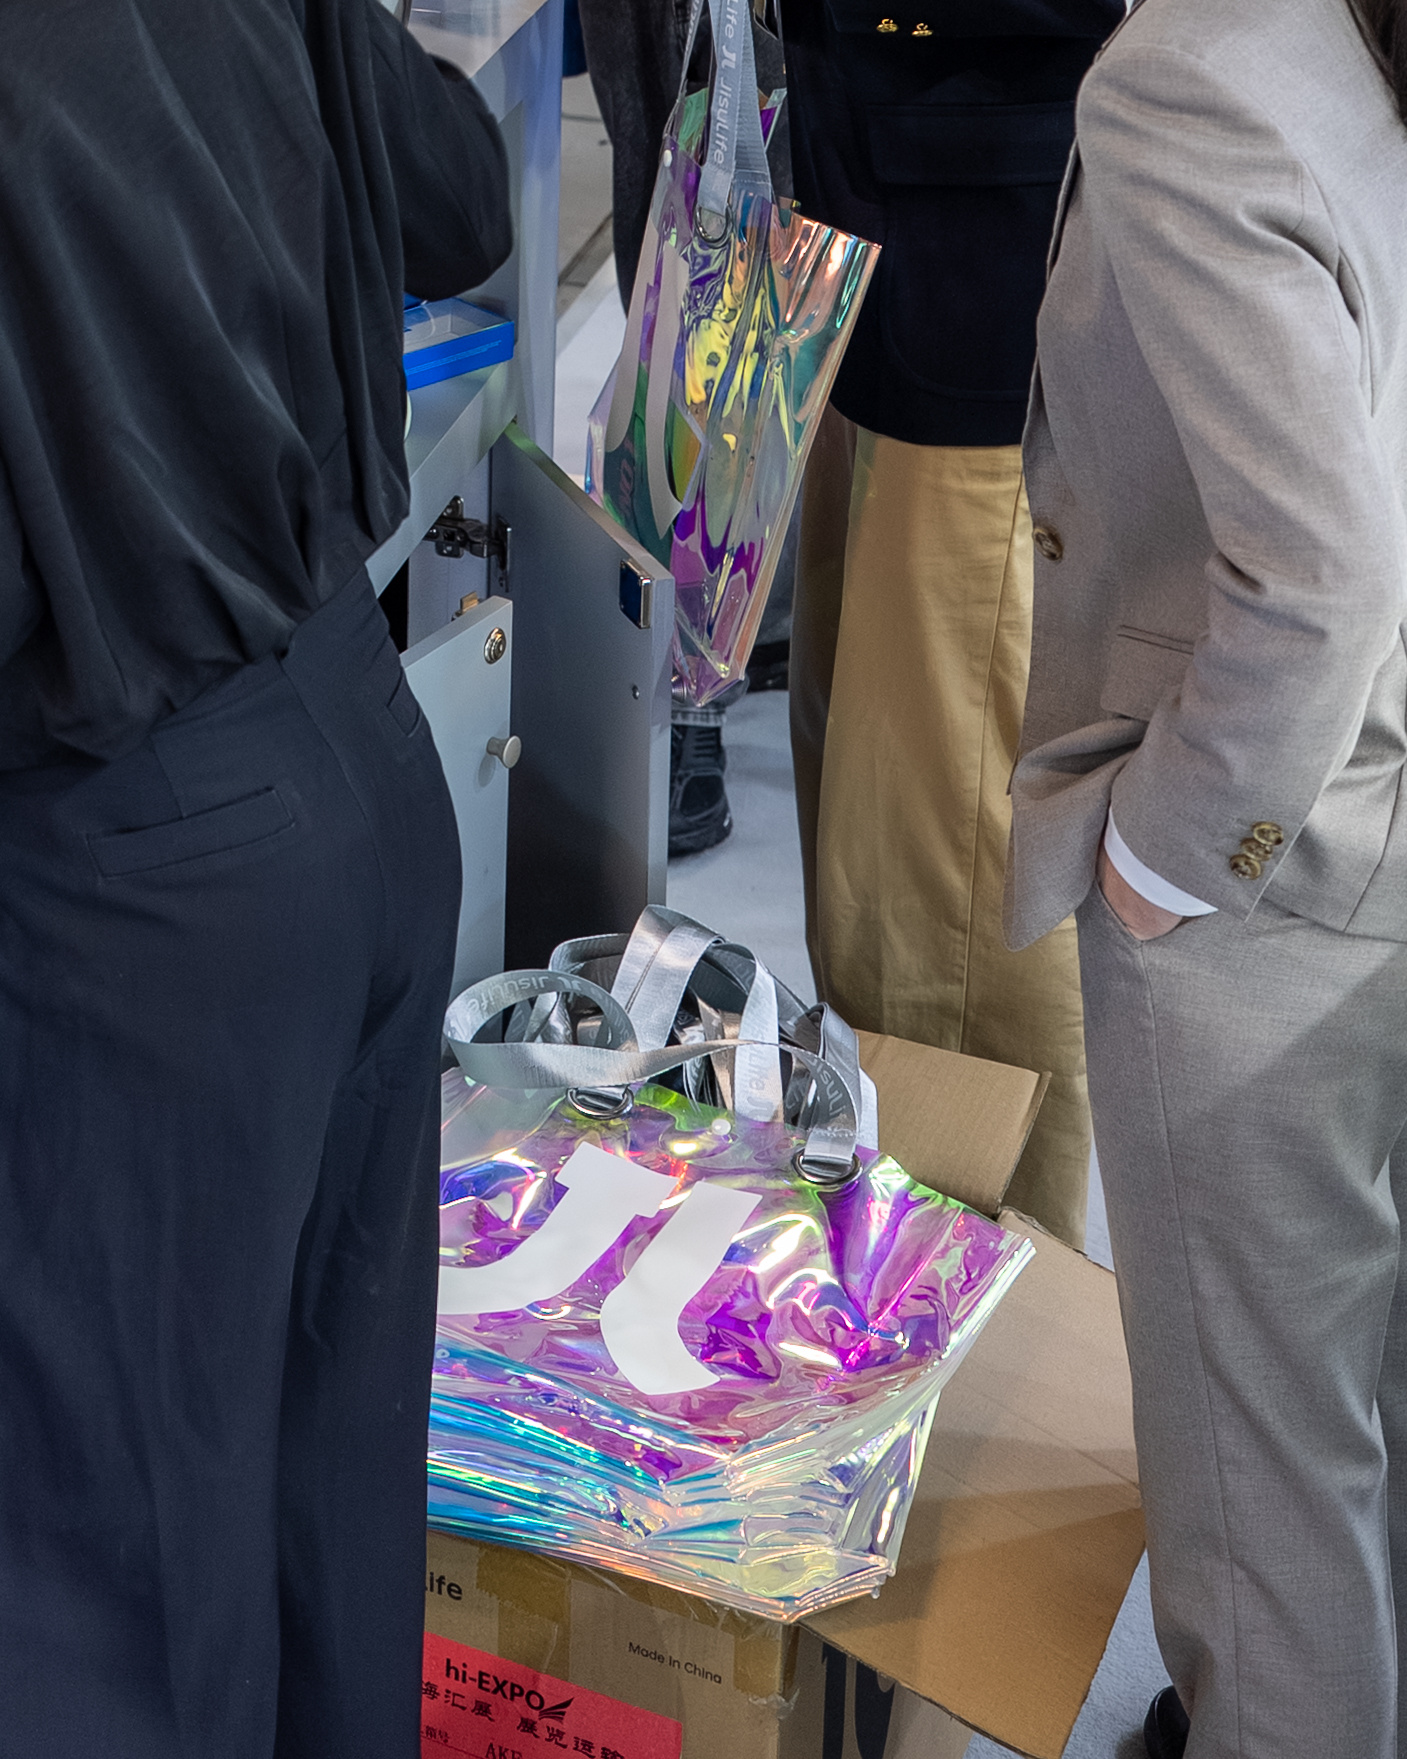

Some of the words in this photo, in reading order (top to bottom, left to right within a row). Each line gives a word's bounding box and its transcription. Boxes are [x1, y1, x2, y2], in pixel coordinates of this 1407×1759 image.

[426, 1571, 463, 1601] ife
[444, 1658, 546, 1711] hi-EXPO
[628, 1642, 665, 1664] Made
[684, 1661, 722, 1685] China
